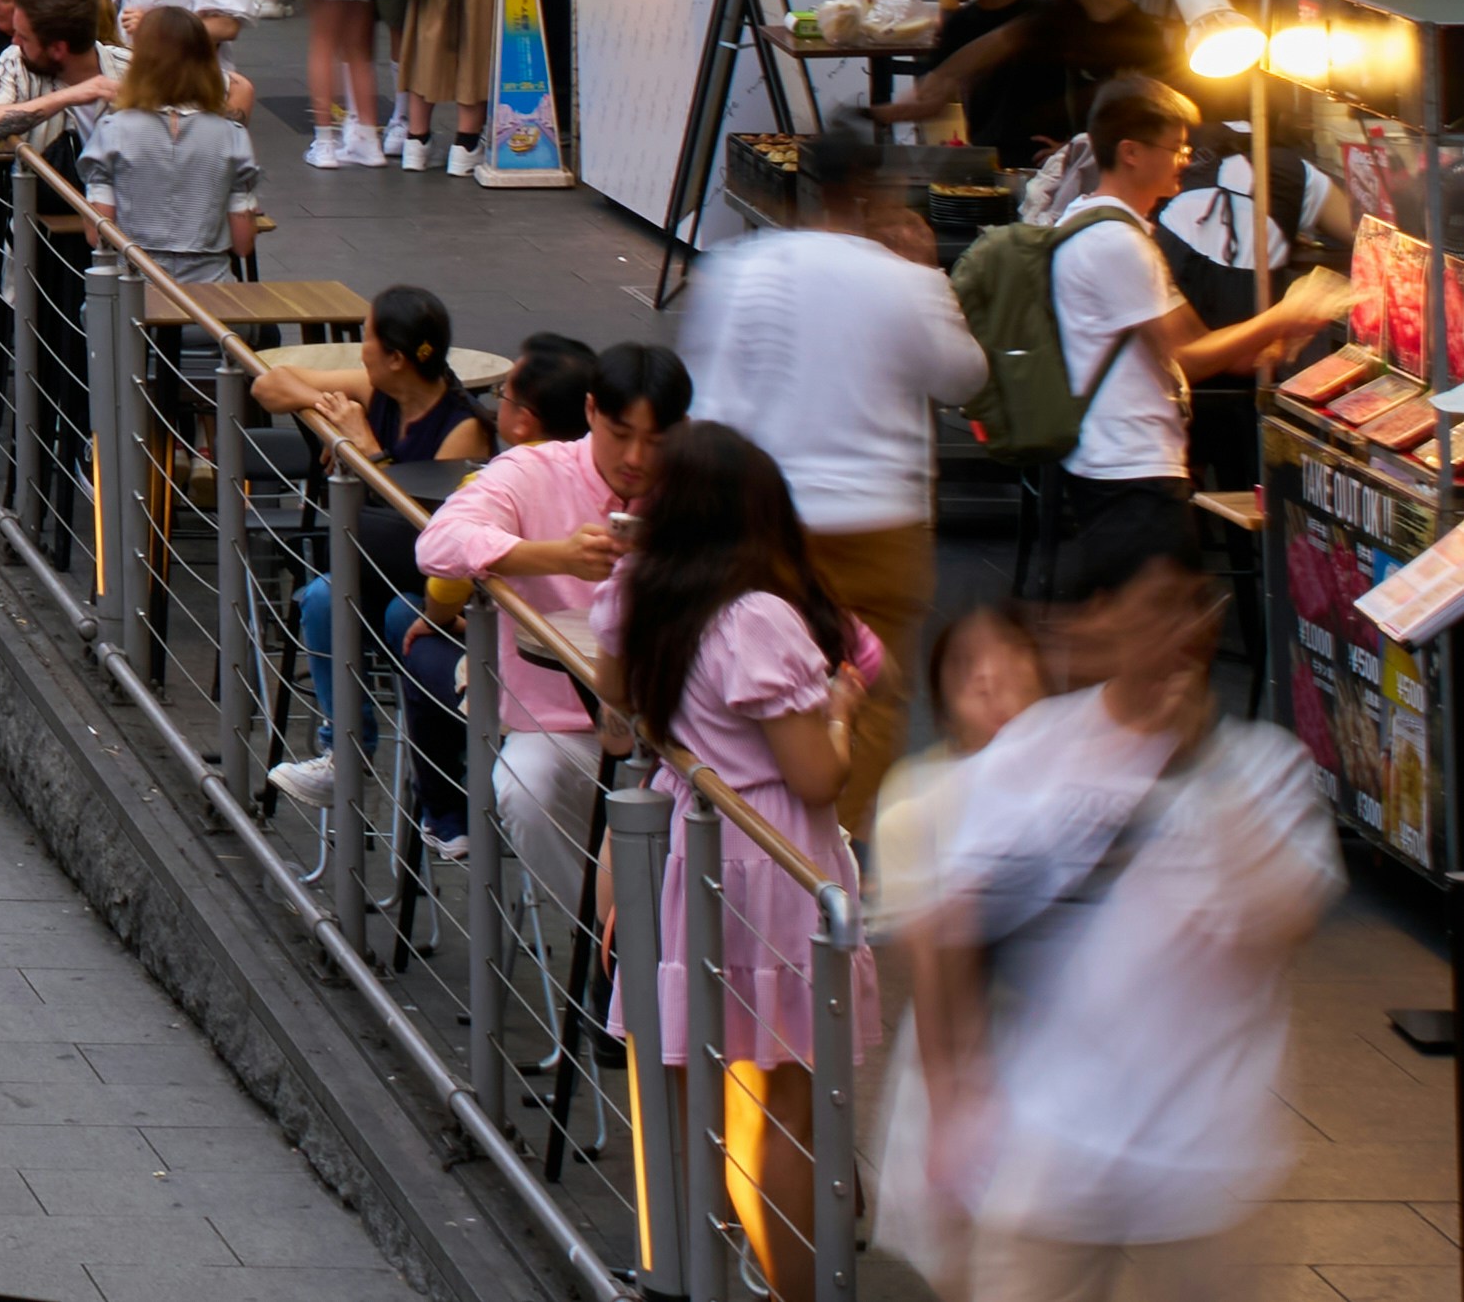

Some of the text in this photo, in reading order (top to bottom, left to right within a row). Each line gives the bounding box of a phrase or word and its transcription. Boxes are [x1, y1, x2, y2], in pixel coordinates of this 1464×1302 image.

[1301, 454, 1332, 516] TAKE
[1333, 472, 1360, 528] OUT
[1348, 643, 1380, 686] ¥500
